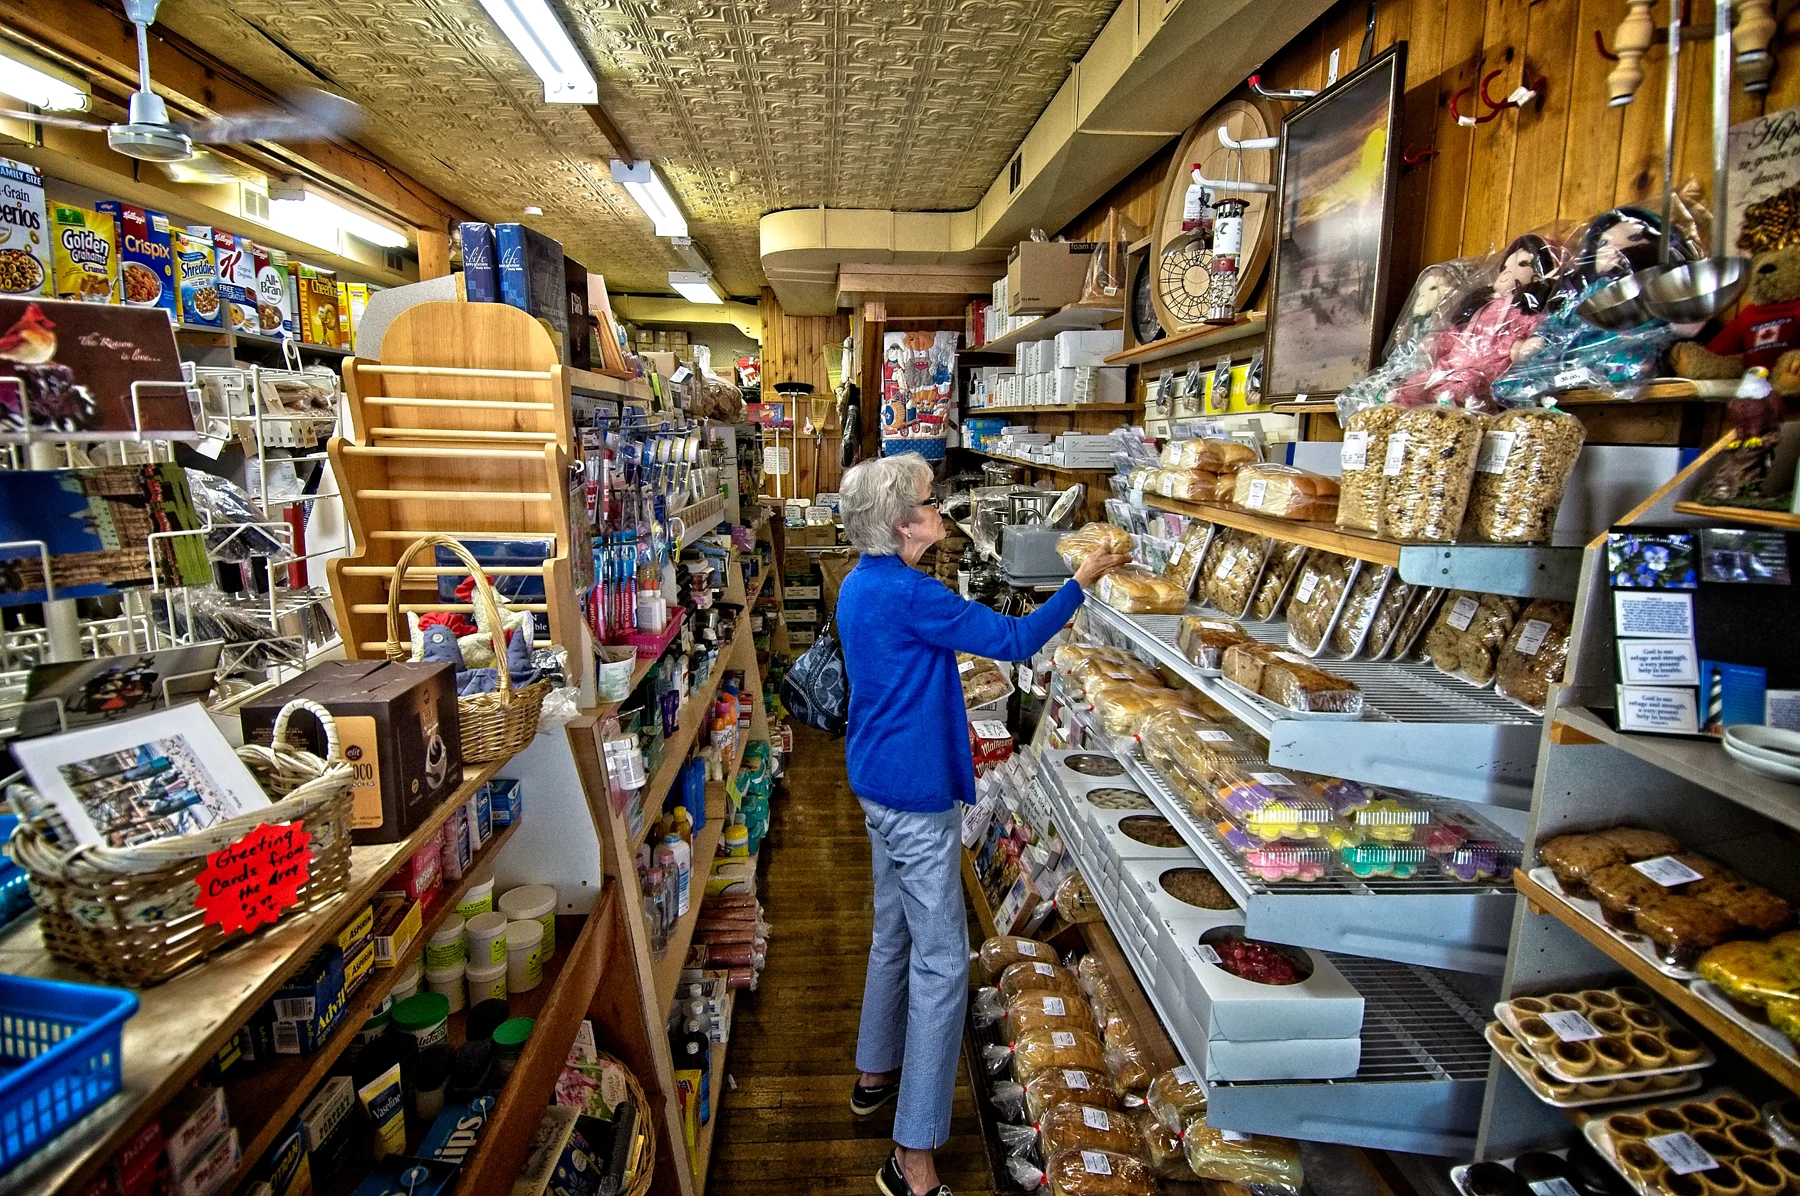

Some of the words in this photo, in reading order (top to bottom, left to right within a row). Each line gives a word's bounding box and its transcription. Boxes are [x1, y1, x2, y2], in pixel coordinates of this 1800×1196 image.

[1748, 151, 1788, 172] grace
[26, 173, 42, 186] SIZE
[1751, 171, 1786, 186] dawn
[123, 210, 145, 225] Kellogg's
[62, 229, 109, 257] Golden
[125, 234, 171, 260] Crispix
[214, 233, 234, 246] Kellogg's
[71, 248, 107, 265] Grahams
[466, 245, 489, 276] life
[500, 246, 521, 276] life
[82, 263, 108, 275] Crunch
[181, 260, 216, 279] Shreddies
[220, 250, 242, 283] K
[219, 284, 235, 293] FREE
[260, 281, 282, 296] Bran
[266, 274, 279, 286] All-
[311, 280, 338, 298] Cheerios
[227, 292, 246, 301] GRATUIT
[1750, 317, 1793, 332] CANADA
[347, 748, 360, 757] elit
[981, 739, 1013, 757] Maltesers
[216, 829, 293, 869] Greeting
[209, 863, 258, 896] Cards
[269, 845, 305, 867] from
[239, 882, 261, 900] the
[269, 865, 299, 886] Area
[349, 912, 372, 939] ASPIRIN
[351, 948, 373, 976] ASPIRIN
[317, 986, 346, 1036] Advil
[372, 1093, 401, 1120] Vaseline
[318, 1094, 350, 1139] PORTER'S
